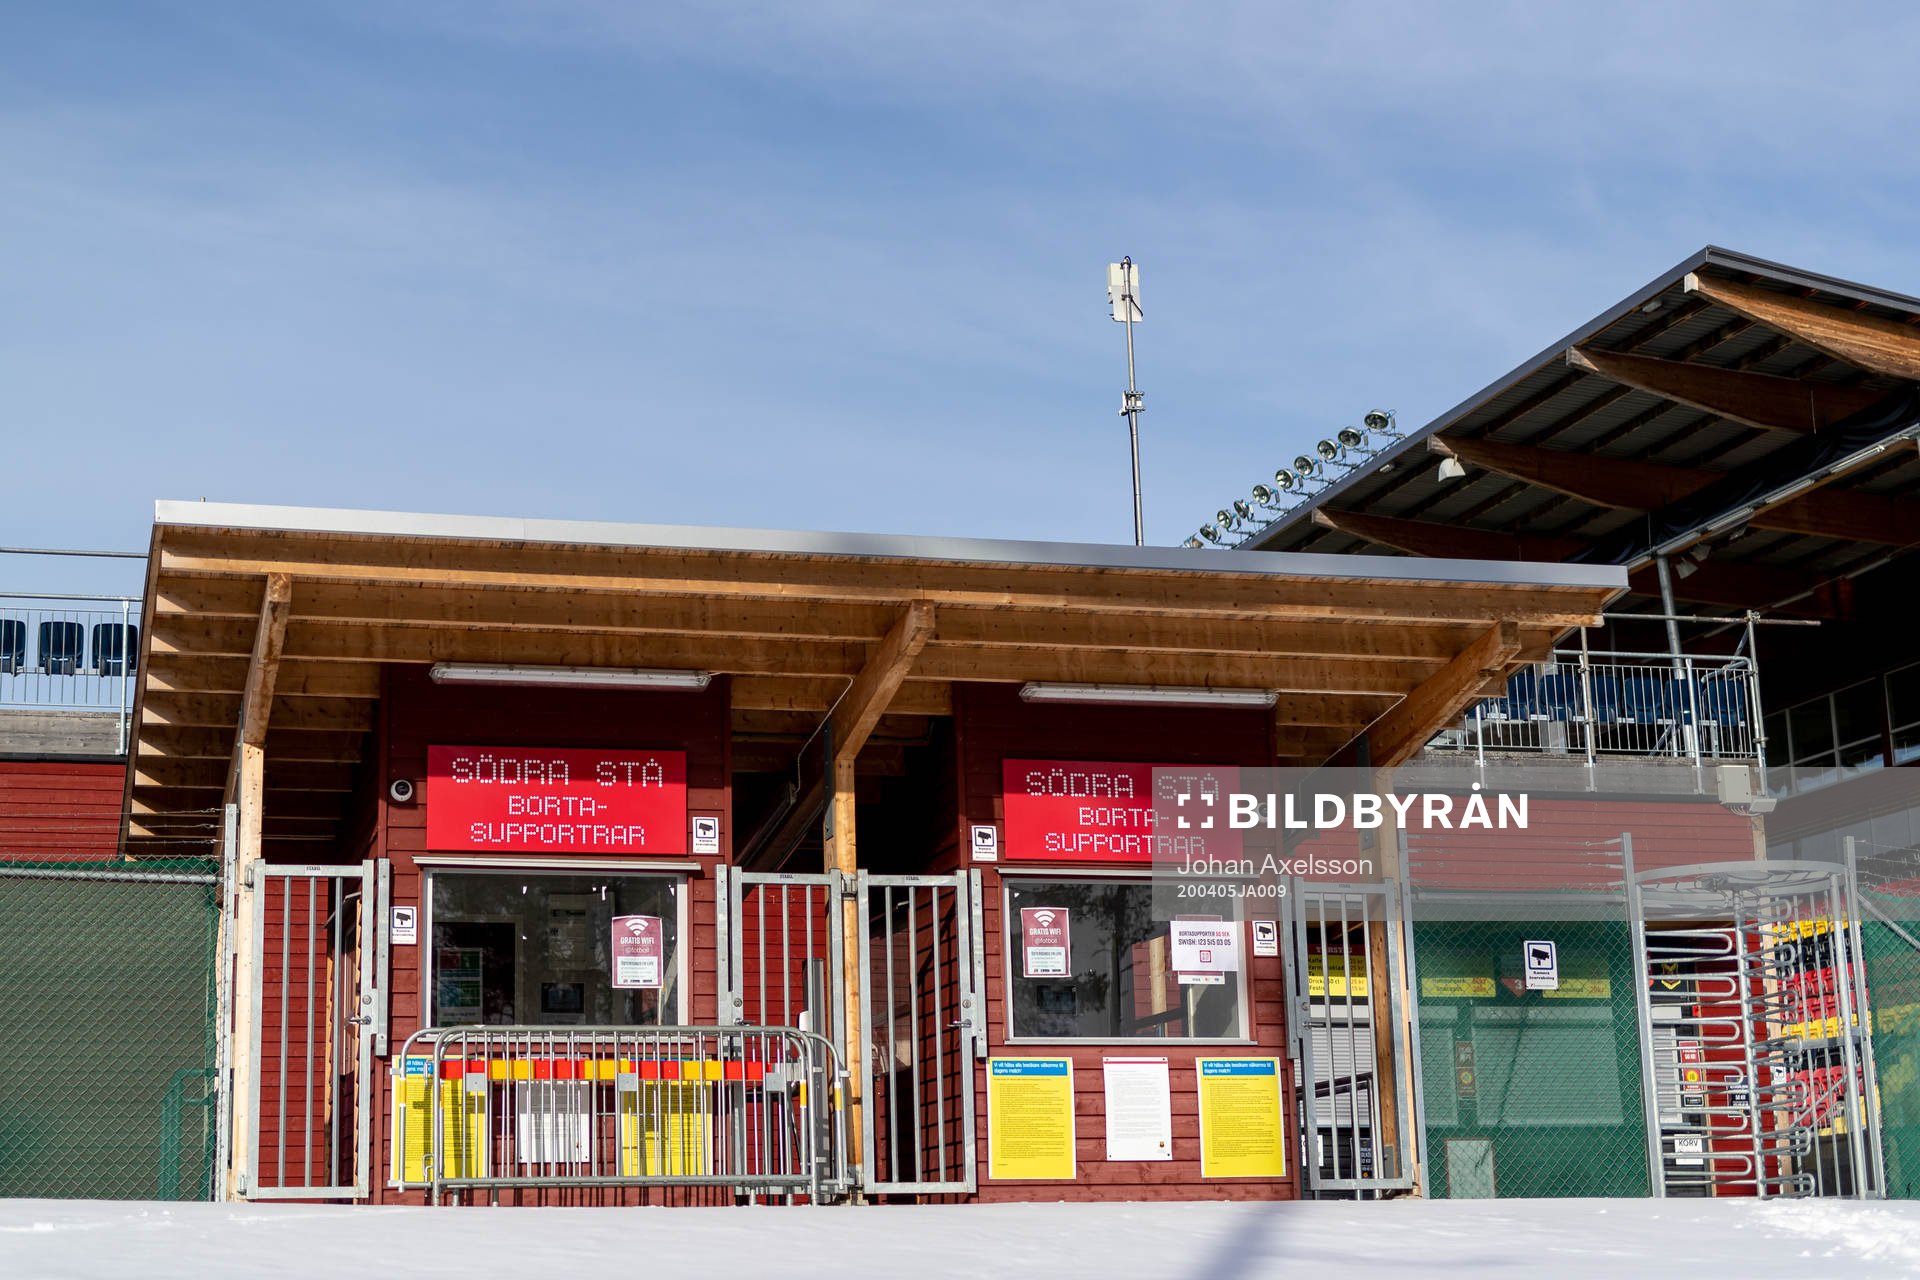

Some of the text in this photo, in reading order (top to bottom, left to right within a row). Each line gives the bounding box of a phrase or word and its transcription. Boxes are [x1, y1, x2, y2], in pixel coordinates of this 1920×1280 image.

[452, 753, 663, 788] SÖDRA STÅ
[1026, 768, 1219, 801] SÖDRA STÅ
[508, 795, 607, 816] BORTA-
[470, 822, 645, 845] SUPPORTRAR
[1045, 833, 1205, 855] SUPPORTRAR
[620, 936, 655, 945] GRATIS WIFI
[1029, 927, 1062, 936] GRATIS WIFI
[1678, 1139, 1699, 1148] KORV
